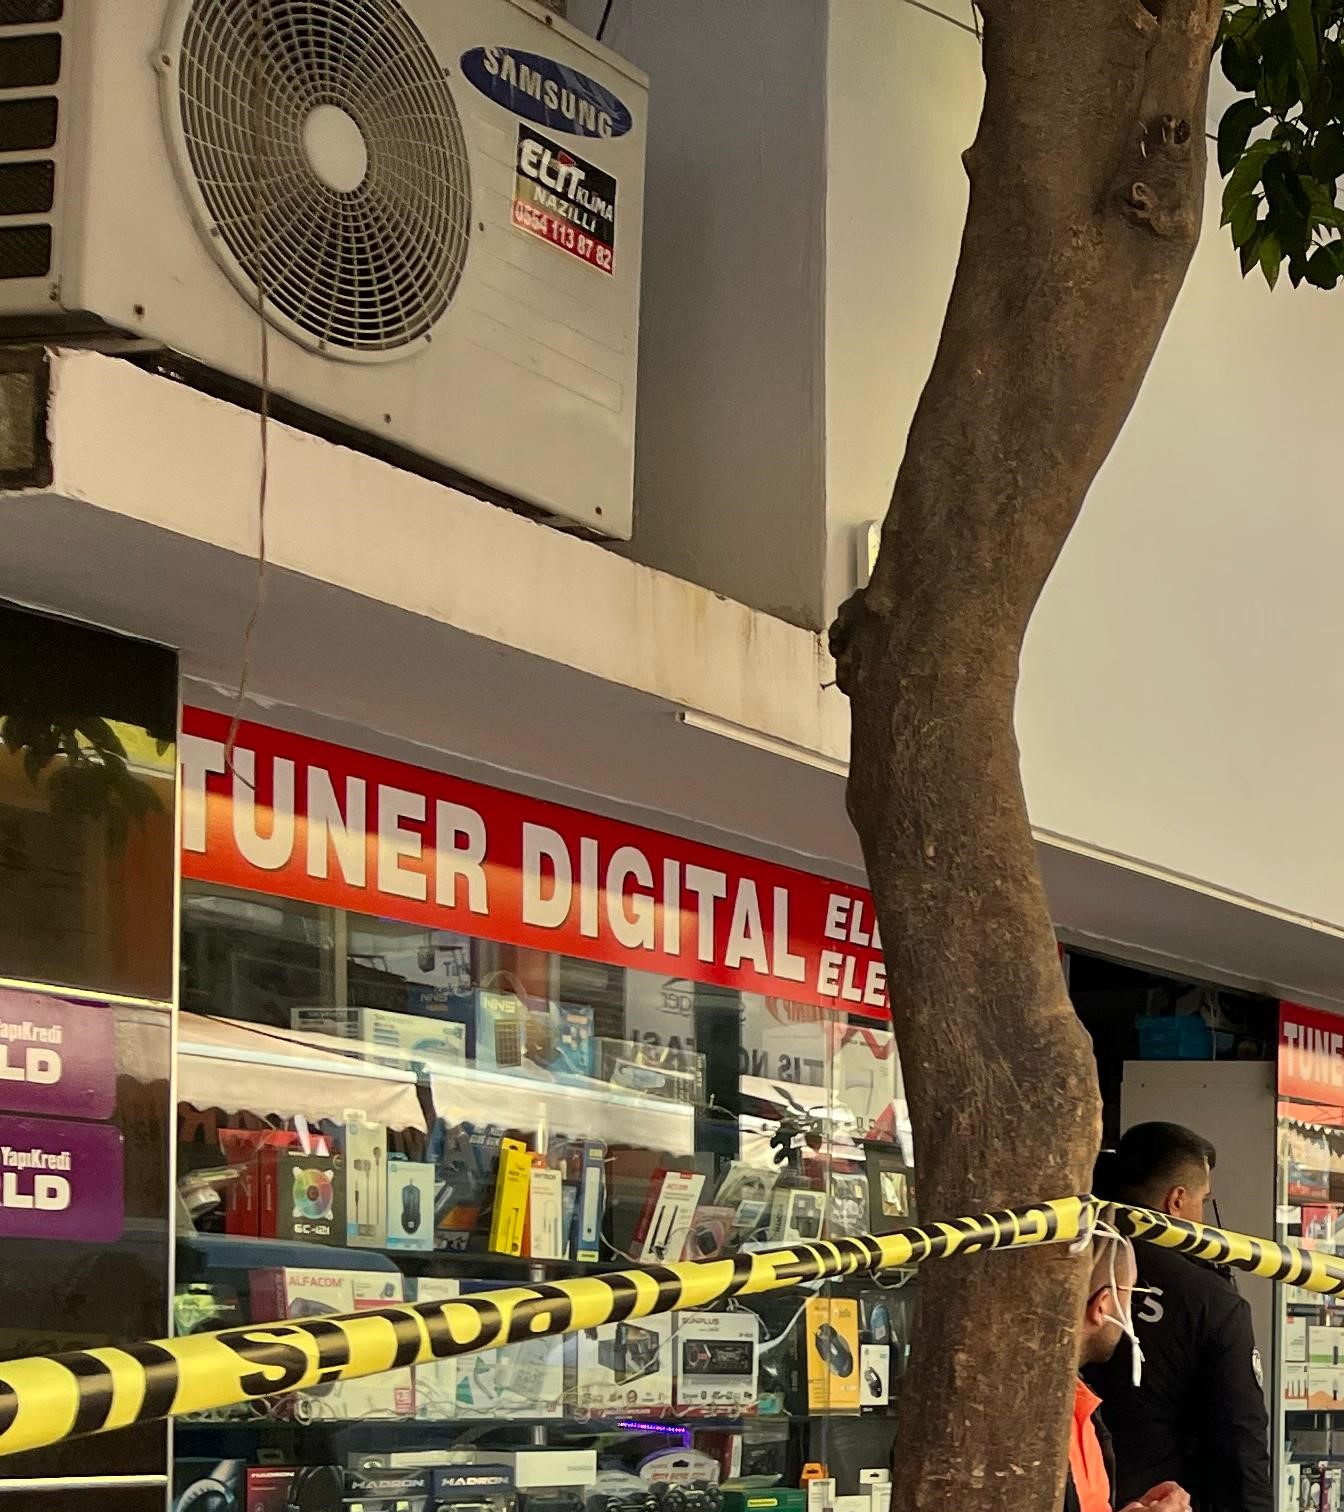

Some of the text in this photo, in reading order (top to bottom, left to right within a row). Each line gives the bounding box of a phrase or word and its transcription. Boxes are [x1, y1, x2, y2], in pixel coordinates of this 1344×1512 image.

[482, 46, 614, 138] SAMSUNG
[552, 221, 575, 250] 113
[578, 234, 595, 258] 87
[178, 733, 490, 915] TUNER
[522, 821, 806, 983] DIGITAL
[289, 1273, 343, 1288] ALFACOM
[440, 1475, 510, 1487] HADRON
